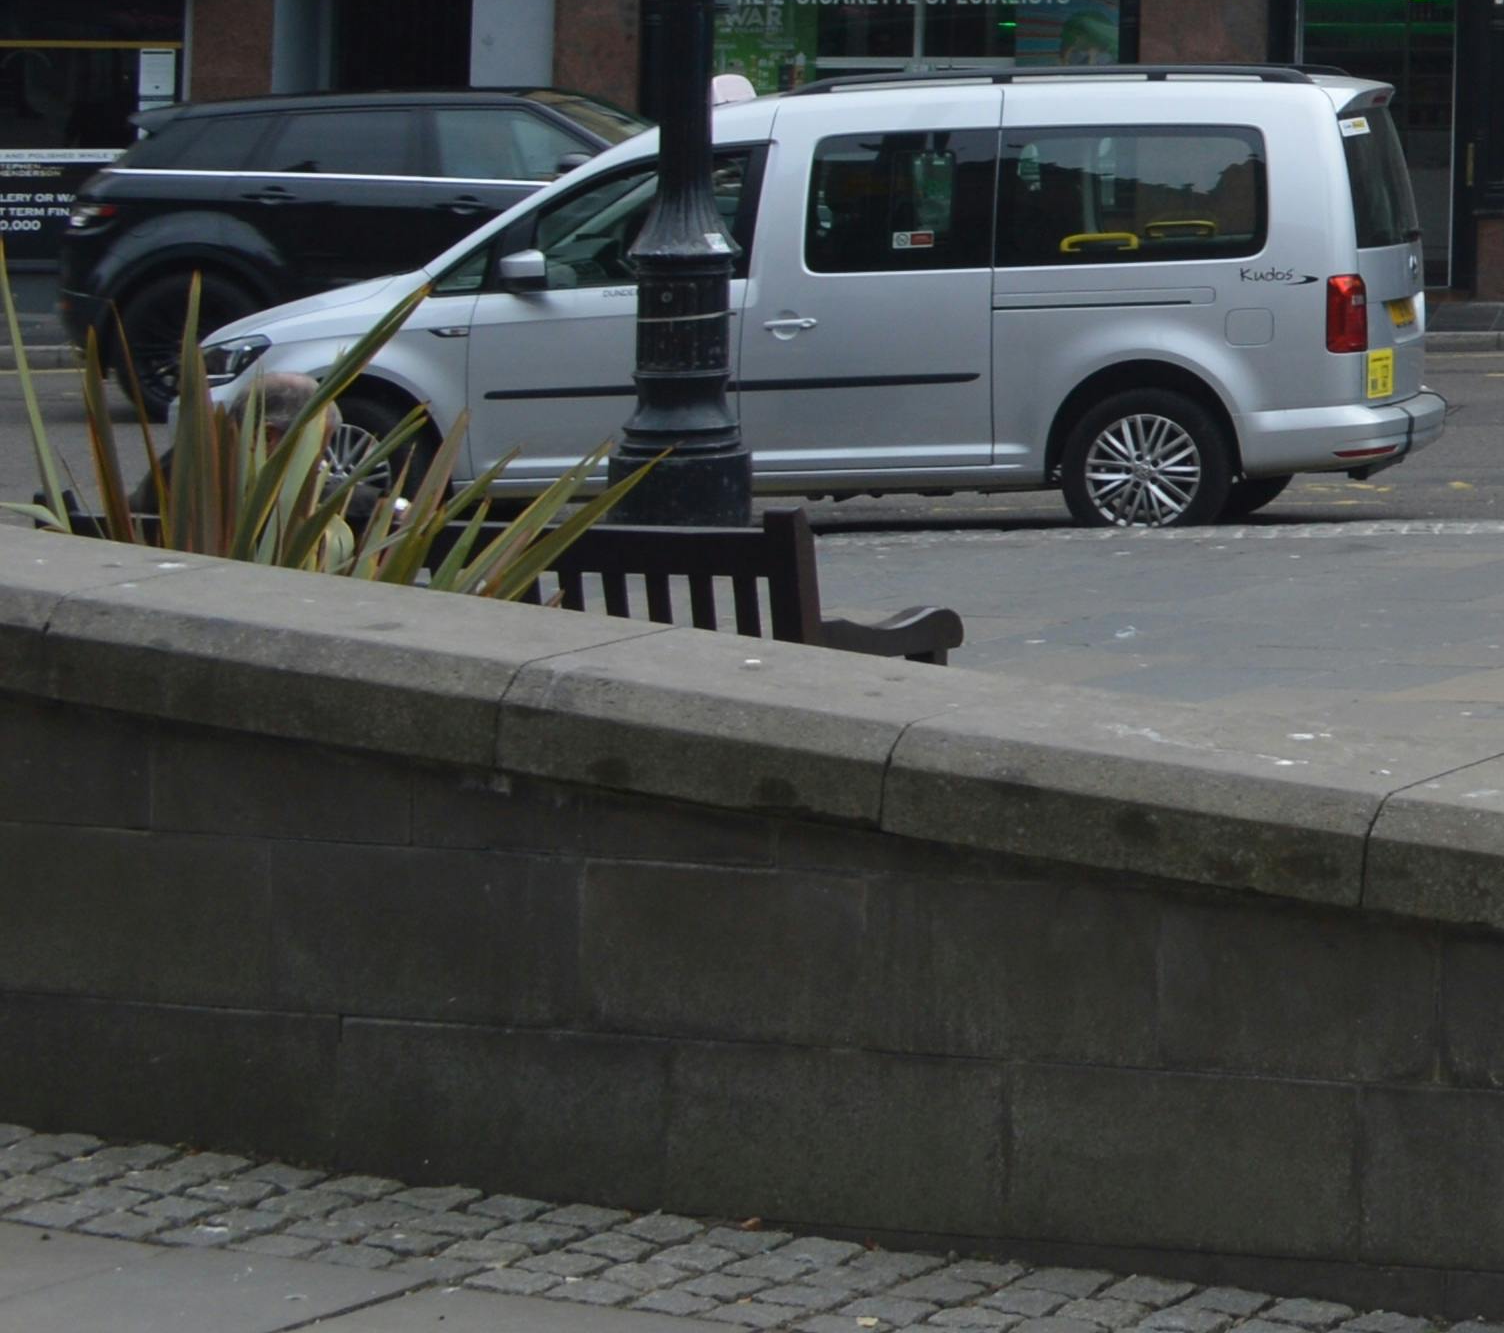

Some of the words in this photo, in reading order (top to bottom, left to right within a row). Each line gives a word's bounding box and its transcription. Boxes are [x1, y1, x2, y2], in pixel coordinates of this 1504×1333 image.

[35, 194, 54, 202] OR
[9, 208, 45, 216] TERM
[1240, 267, 1295, 282] Kudos
[603, 289, 637, 298] DUNDE
